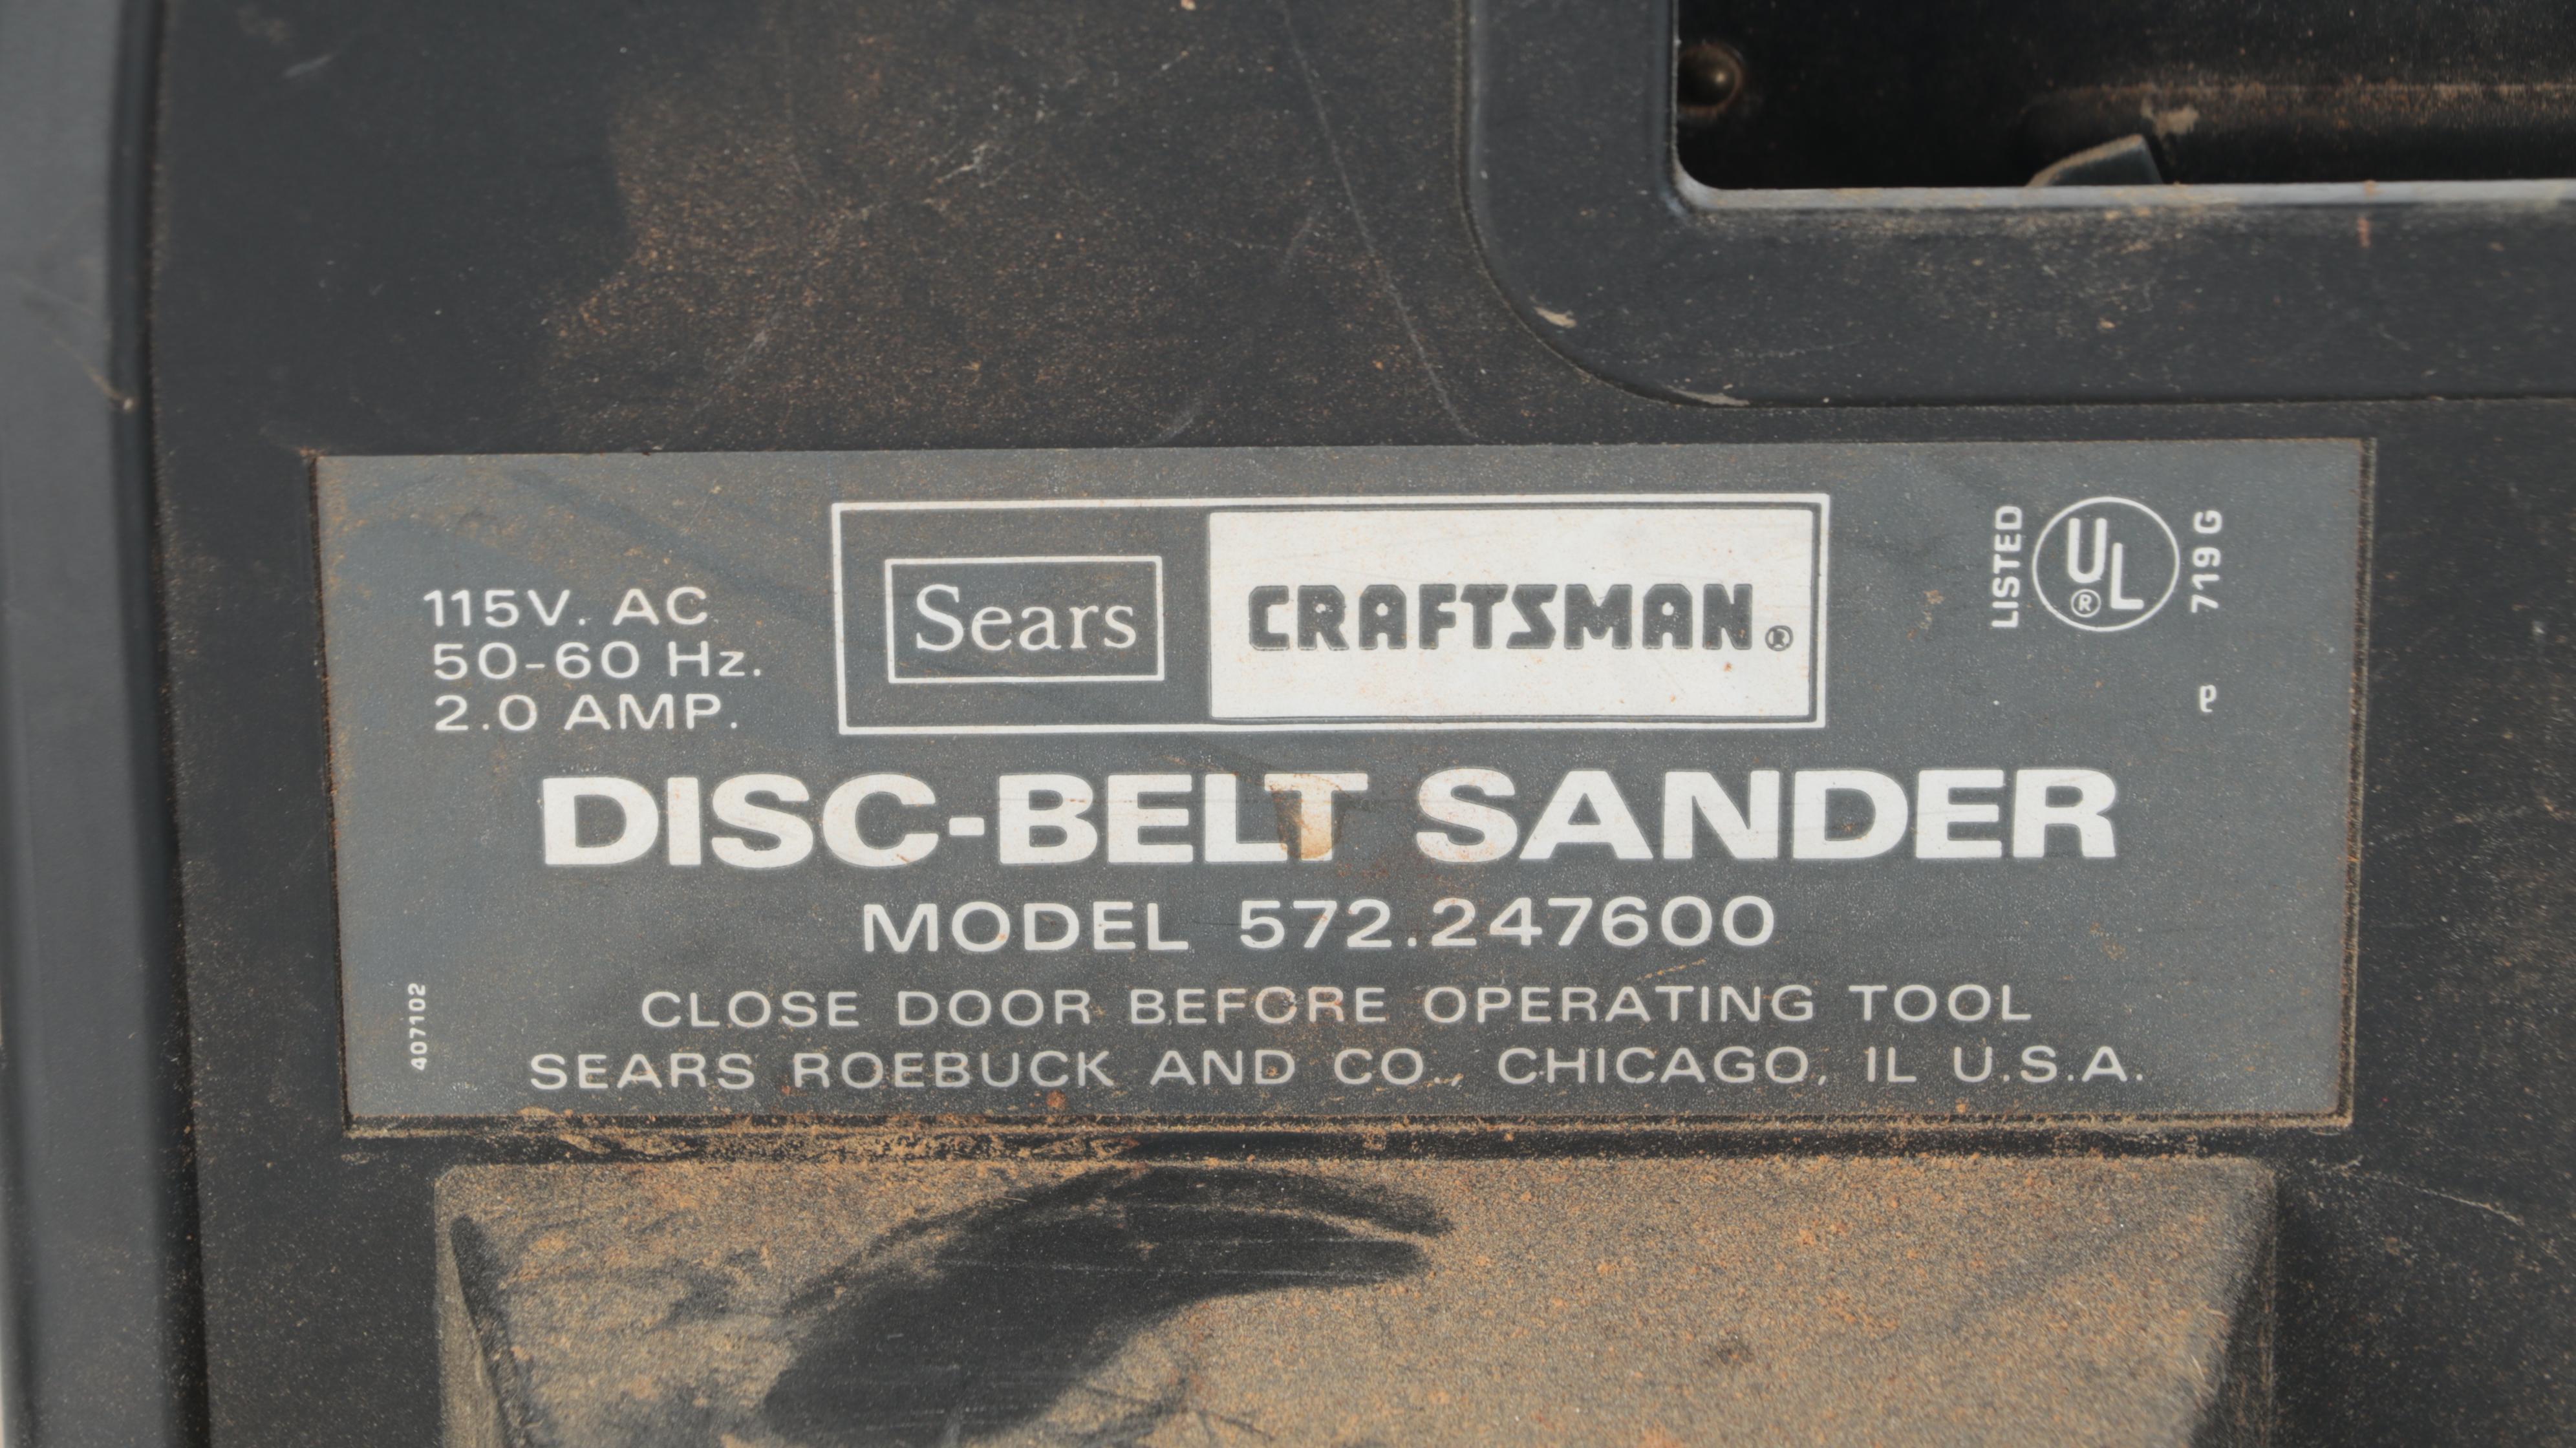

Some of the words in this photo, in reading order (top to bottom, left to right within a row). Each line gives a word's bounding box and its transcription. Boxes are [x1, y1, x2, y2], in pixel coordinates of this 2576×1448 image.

[1991, 506, 2023, 628] LISTED
[2068, 518, 2144, 610] UL
[424, 589, 589, 628] 115V.
[612, 586, 708, 626] AC
[916, 583, 1137, 652] Sears
[1249, 583, 1752, 651] CRAFTSMAN
[434, 641, 640, 681] 50-60
[668, 641, 761, 677] Hz.
[435, 694, 537, 732] 2.0
[564, 693, 738, 730] AMP.
[542, 772, 1369, 869] DISC-BELT
[1416, 767, 2117, 863] SANDER
[863, 900, 1189, 953] MODEL
[1240, 895, 1775, 950] 572.247600
[407, 983, 428, 1071] 407102
[641, 990, 859, 1028] CLOSE
[897, 988, 1090, 1027] DOOR
[1130, 986, 1386, 1025] BEFORE
[1423, 984, 1814, 1024] OPERATING
[1849, 983, 2032, 1022] TOOL
[530, 1052, 755, 1091] SEARS
[793, 1050, 1114, 1089] ROEBUCK
[1150, 1049, 1295, 1085] AND
[1497, 1046, 1827, 1085] CHICAGO,
[1865, 1046, 1916, 1083] IL
[1953, 1045, 2143, 1083] U.S.A.
